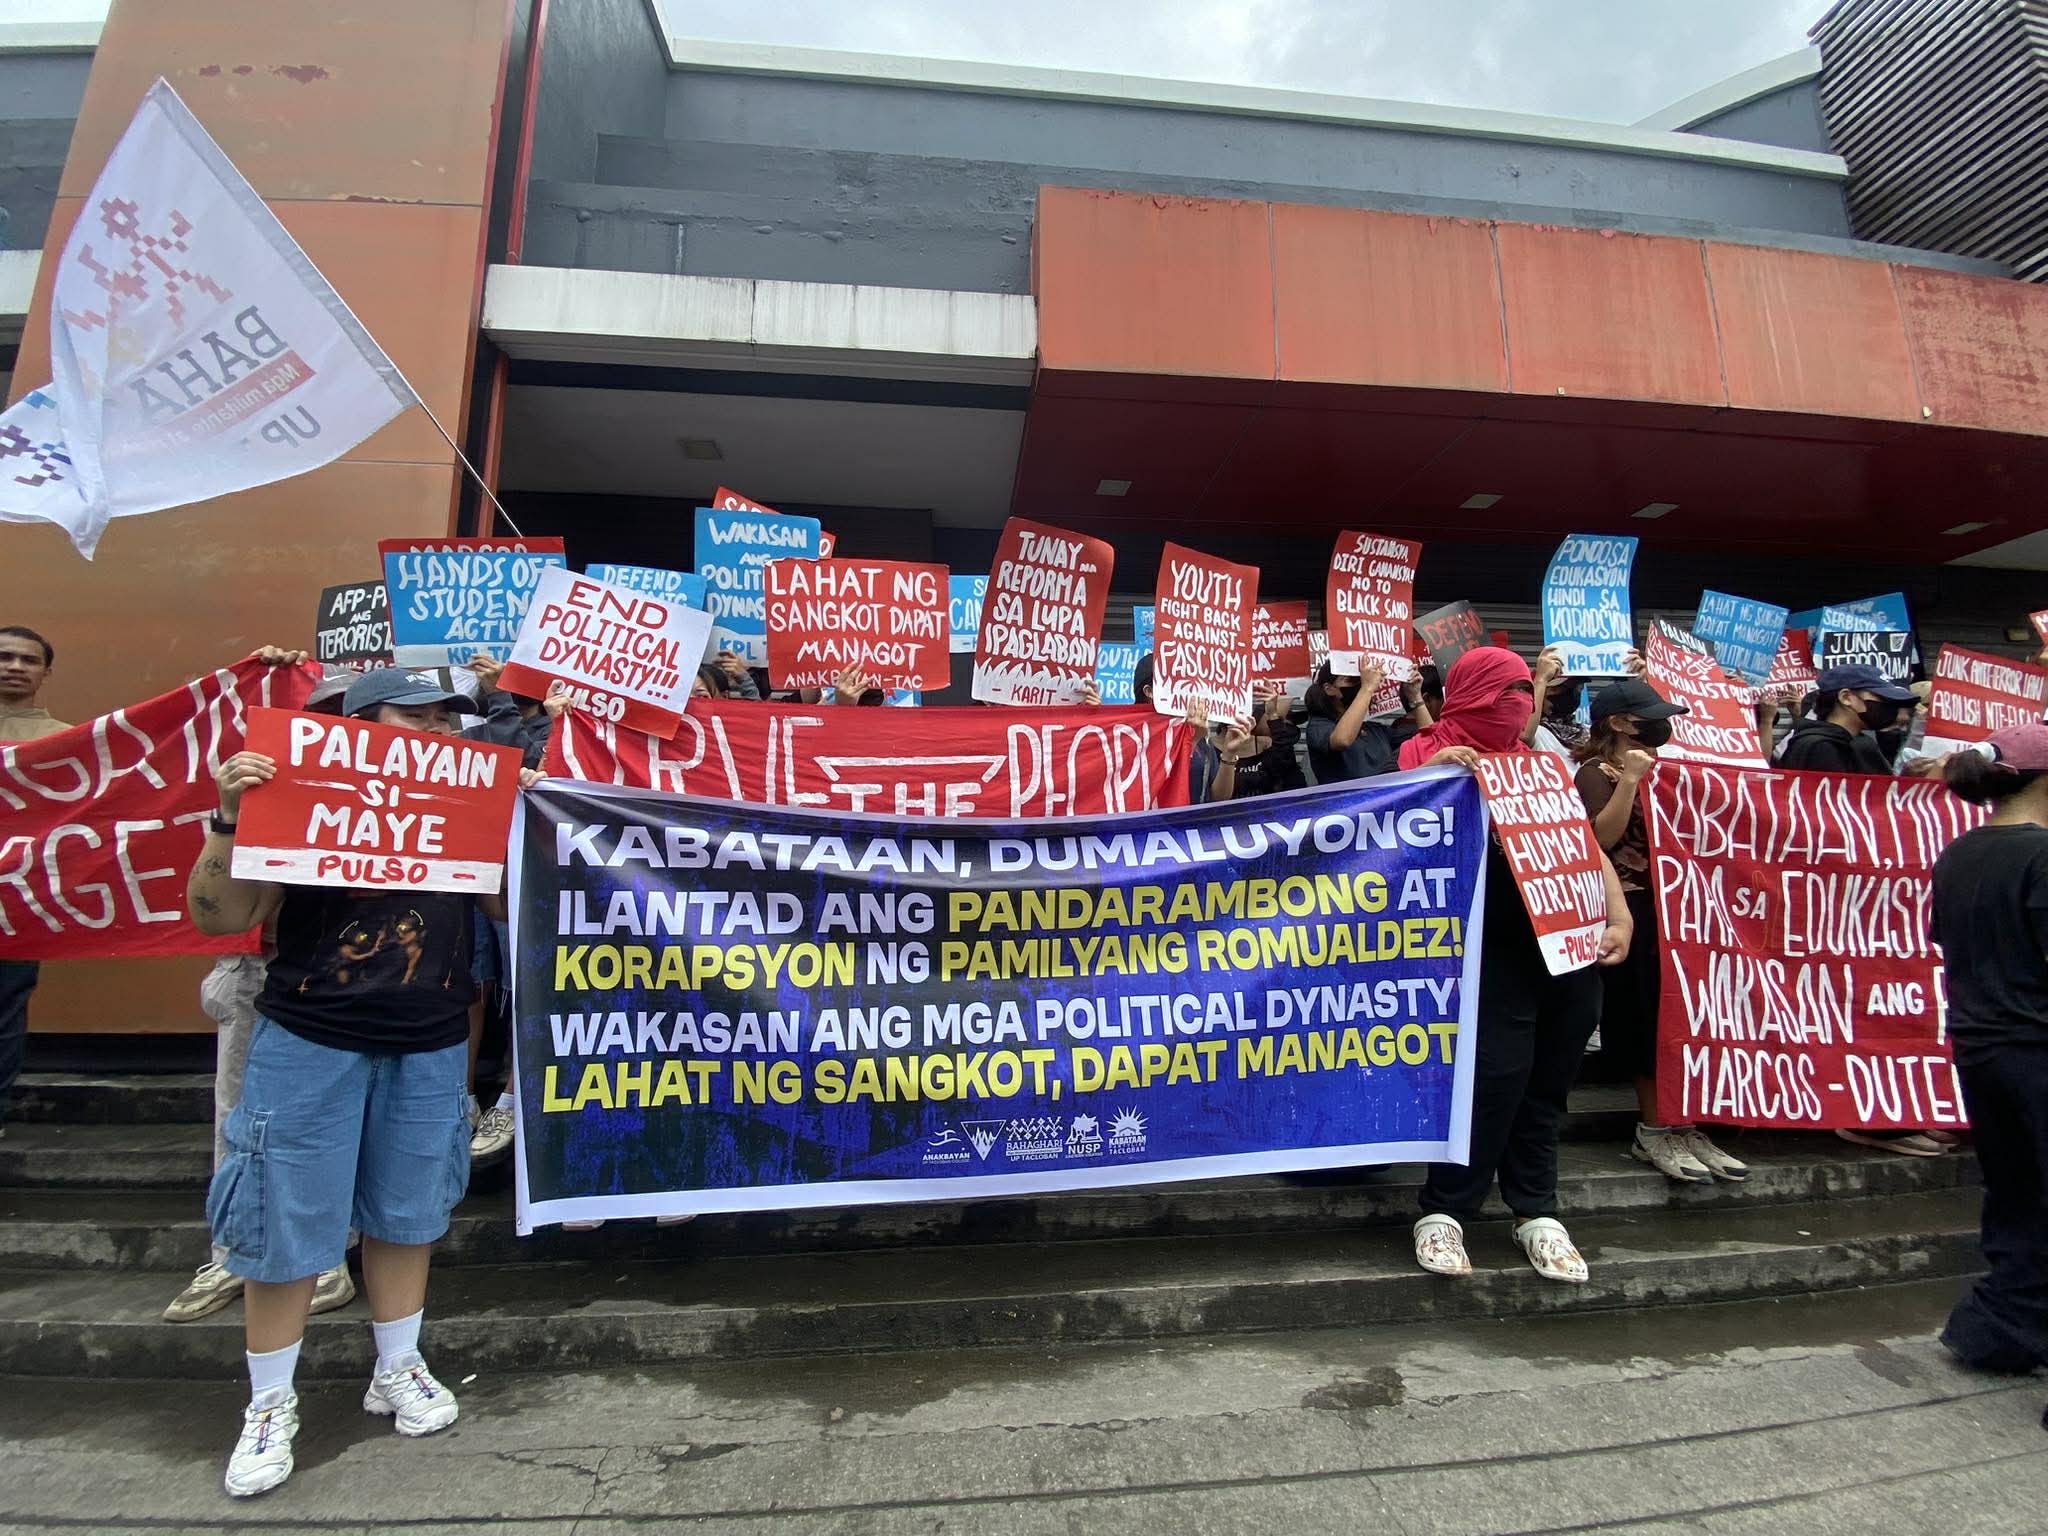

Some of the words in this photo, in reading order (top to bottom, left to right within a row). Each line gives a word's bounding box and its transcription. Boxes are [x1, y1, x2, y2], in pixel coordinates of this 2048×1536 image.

[708, 518, 807, 549] WAKASAN
[1018, 531, 1083, 572] TUNAY
[399, 555, 506, 590] HANDS
[1333, 553, 1365, 574] DIRI
[1558, 540, 1611, 565] PONDO
[1609, 542, 1630, 567] SA
[604, 566, 682, 592] DEFEND
[770, 564, 883, 598] LAHAT
[893, 571, 937, 607] NG
[996, 560, 1087, 607] REPORMA
[1171, 560, 1242, 611] YOUTH
[1352, 576, 1371, 591] NO
[1376, 580, 1391, 594] TO
[1550, 565, 1628, 587] EDUKASYON
[566, 580, 668, 630] END
[993, 592, 1023, 626] SA
[1031, 600, 1085, 637] LUPA
[1161, 597, 1199, 620] FIGHT
[1203, 607, 1241, 631] BACK
[1337, 589, 1380, 616] BLACK
[1384, 599, 1408, 620] SAND
[1547, 588, 1585, 606] HINDI
[1599, 588, 1620, 610] SA
[539, 604, 680, 671] POLITICAL
[769, 601, 884, 635] SANGKOT
[889, 607, 946, 640] DAPAT
[1345, 617, 1406, 655] MINING!
[1550, 607, 1631, 640] KORAPSYON
[796, 638, 925, 672] MANAGOT
[985, 622, 1096, 667] IPAGLABAN
[1830, 632, 1878, 653] JUNK
[539, 636, 680, 700] DYNASTY!!!
[1160, 640, 1247, 688] FASCISM!
[1567, 655, 1595, 672] KPL
[1600, 653, 1622, 672] TAC
[1936, 651, 1970, 681] JUNK
[2022, 673, 2044, 700] LAW
[1011, 684, 1056, 706] KARIT
[1932, 690, 1981, 727] ABOLISH
[290, 718, 497, 788] PALAYAIN
[1664, 714, 1753, 753] ERRORIST
[358, 780, 399, 807] SI
[1481, 755, 1563, 795] BUGAS
[1488, 796, 1532, 825] DIRI
[1524, 787, 1586, 825] BARAS
[1648, 762, 1893, 871] KABATAAN,
[306, 803, 446, 853] MAYE
[556, 823, 972, 878] KABATAAN,
[989, 807, 1455, 872] DUMALUYONG!
[317, 855, 428, 883] PULSO
[1507, 826, 1588, 873] HUMAY
[558, 891, 803, 935] ILANTAD
[817, 892, 934, 933] ANG
[949, 871, 1387, 932] PANDARAMBONG
[1397, 868, 1456, 910] AT
[1522, 874, 1574, 916] DIRI
[1732, 887, 1767, 920] SA
[554, 942, 855, 991] KORAPSYON
[866, 942, 930, 984] NG
[941, 935, 1190, 981] PAMILYANG
[1199, 917, 1463, 973] ROMUALDEZ!
[1671, 949, 1854, 1045] WAKASAN
[1867, 982, 1925, 1015] ANG
[550, 1010, 800, 1057] WAKASAN
[810, 1006, 912, 1052] ANG
[923, 1002, 1028, 1046] MGA
[1037, 991, 1256, 1041] POLITICAL
[543, 1060, 720, 1113] LAHAT
[732, 1058, 802, 1104] NG
[814, 1048, 1061, 1104] SANGKOT,
[1073, 1040, 1227, 1093] DAPAT
[1237, 1022, 1458, 1079] MANAGOT
[1682, 1043, 1822, 1122] MARCOS
[922, 1152, 970, 1161] ANAKBAYAN
[1006, 1139, 1062, 1151] BAHAGHARI
[1068, 1143, 1101, 1155] NUSP
